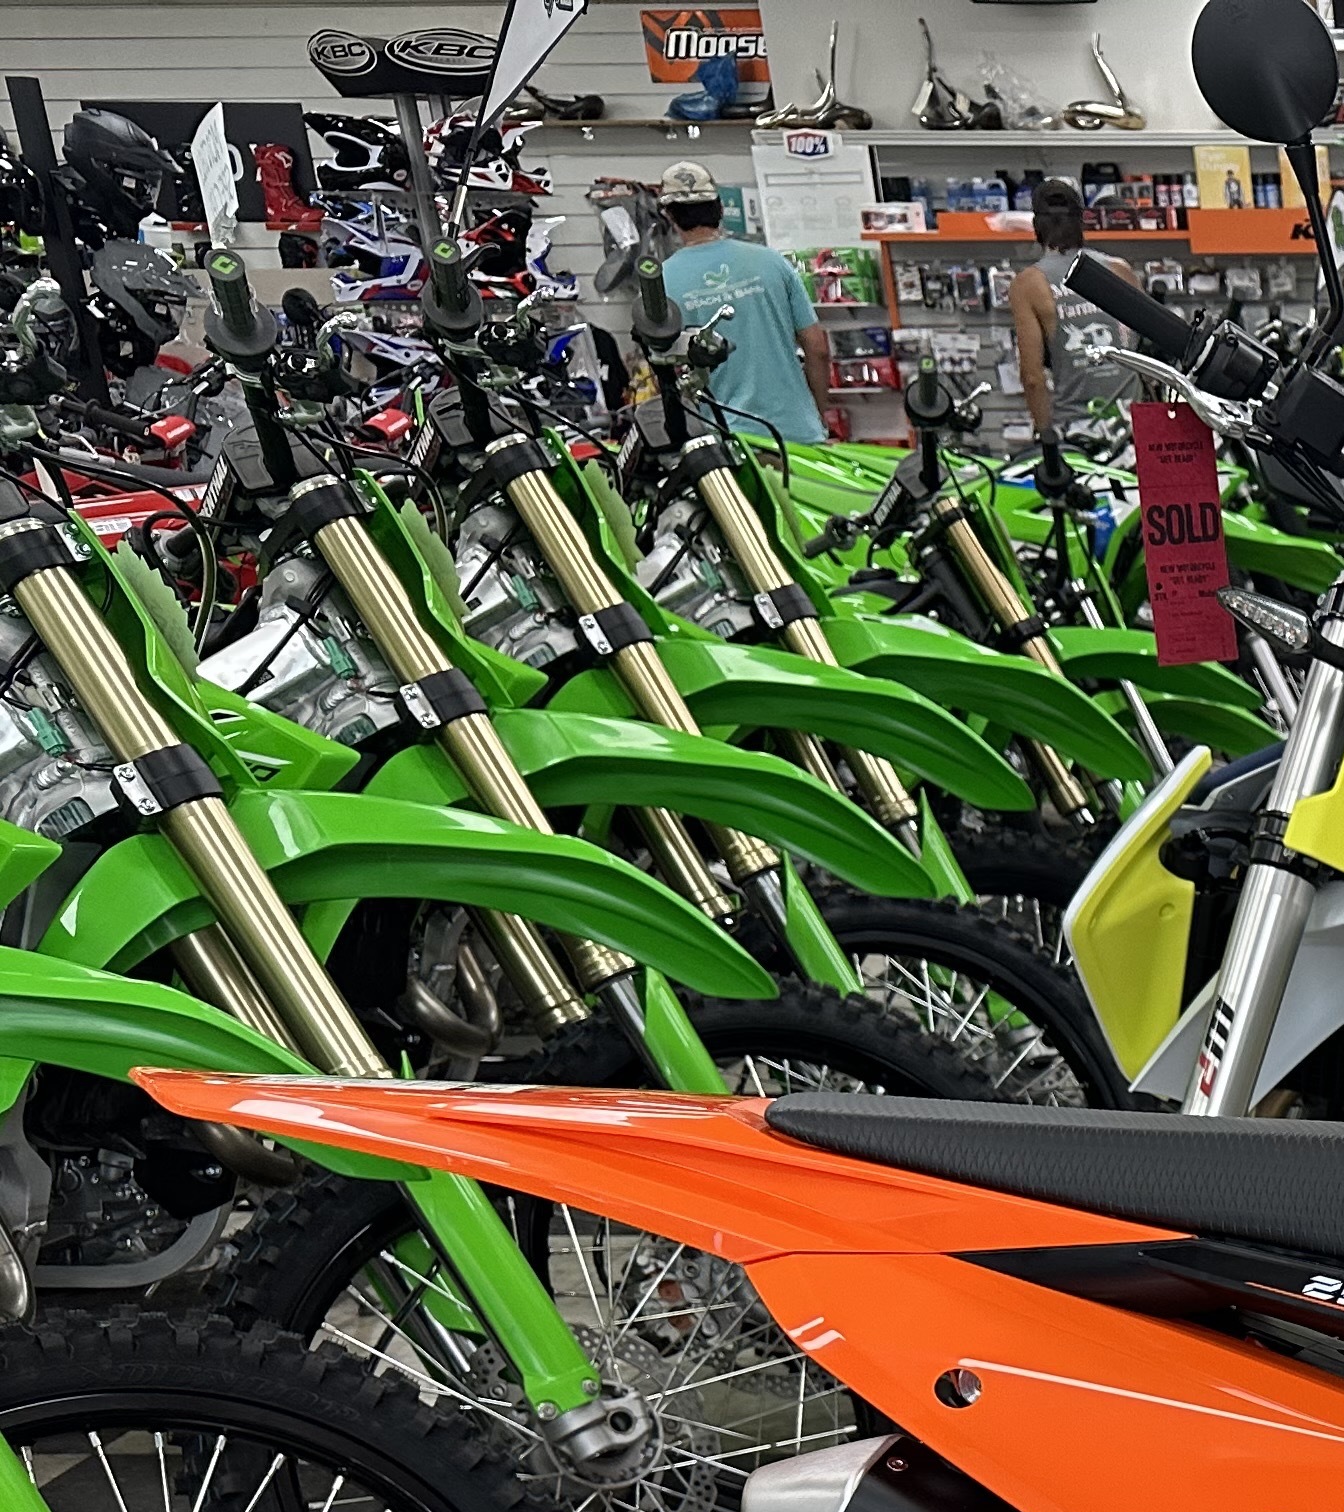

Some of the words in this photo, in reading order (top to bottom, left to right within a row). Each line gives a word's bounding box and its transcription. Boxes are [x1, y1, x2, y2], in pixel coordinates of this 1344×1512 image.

[313, 42, 366, 59] KBC
[395, 40, 497, 59] KBC
[788, 135, 827, 154] 100%
[1146, 502, 1221, 547] SOLD
